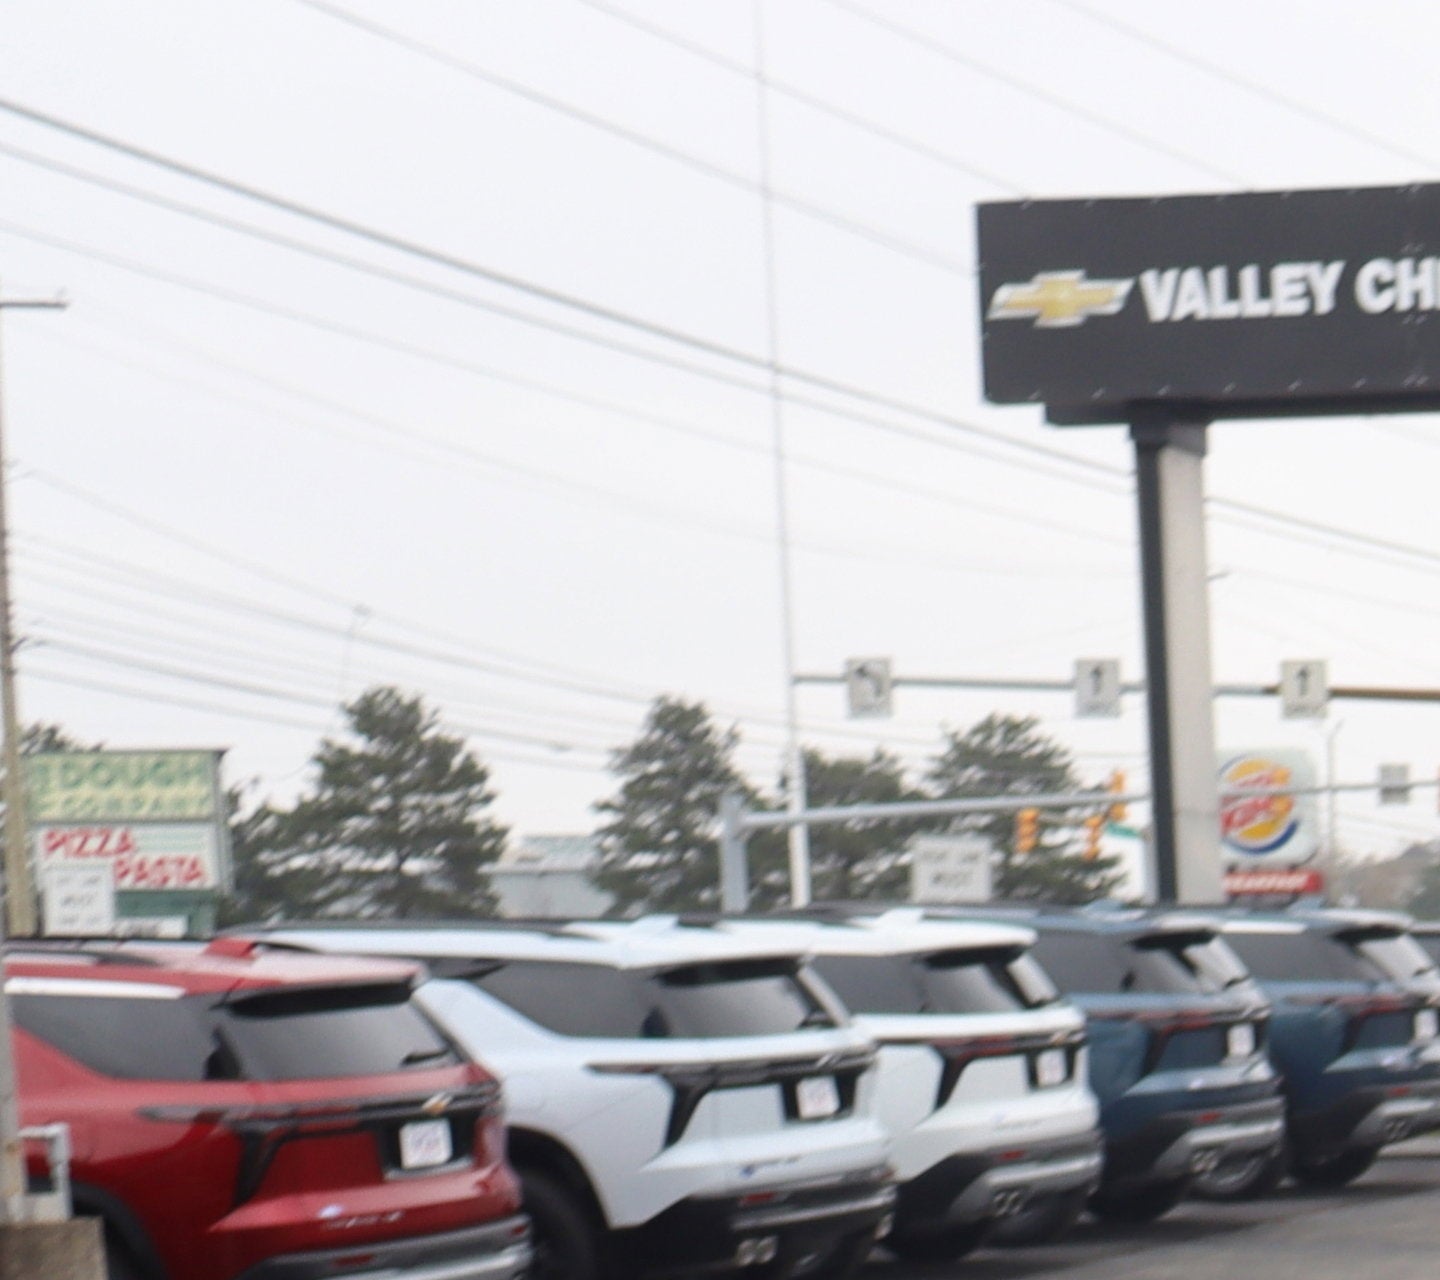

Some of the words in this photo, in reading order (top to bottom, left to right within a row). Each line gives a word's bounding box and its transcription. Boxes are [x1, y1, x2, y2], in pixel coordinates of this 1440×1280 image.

[1140, 259, 1346, 323] VALLEY
[44, 826, 134, 859] PIZZA
[114, 856, 206, 886] PASTA
